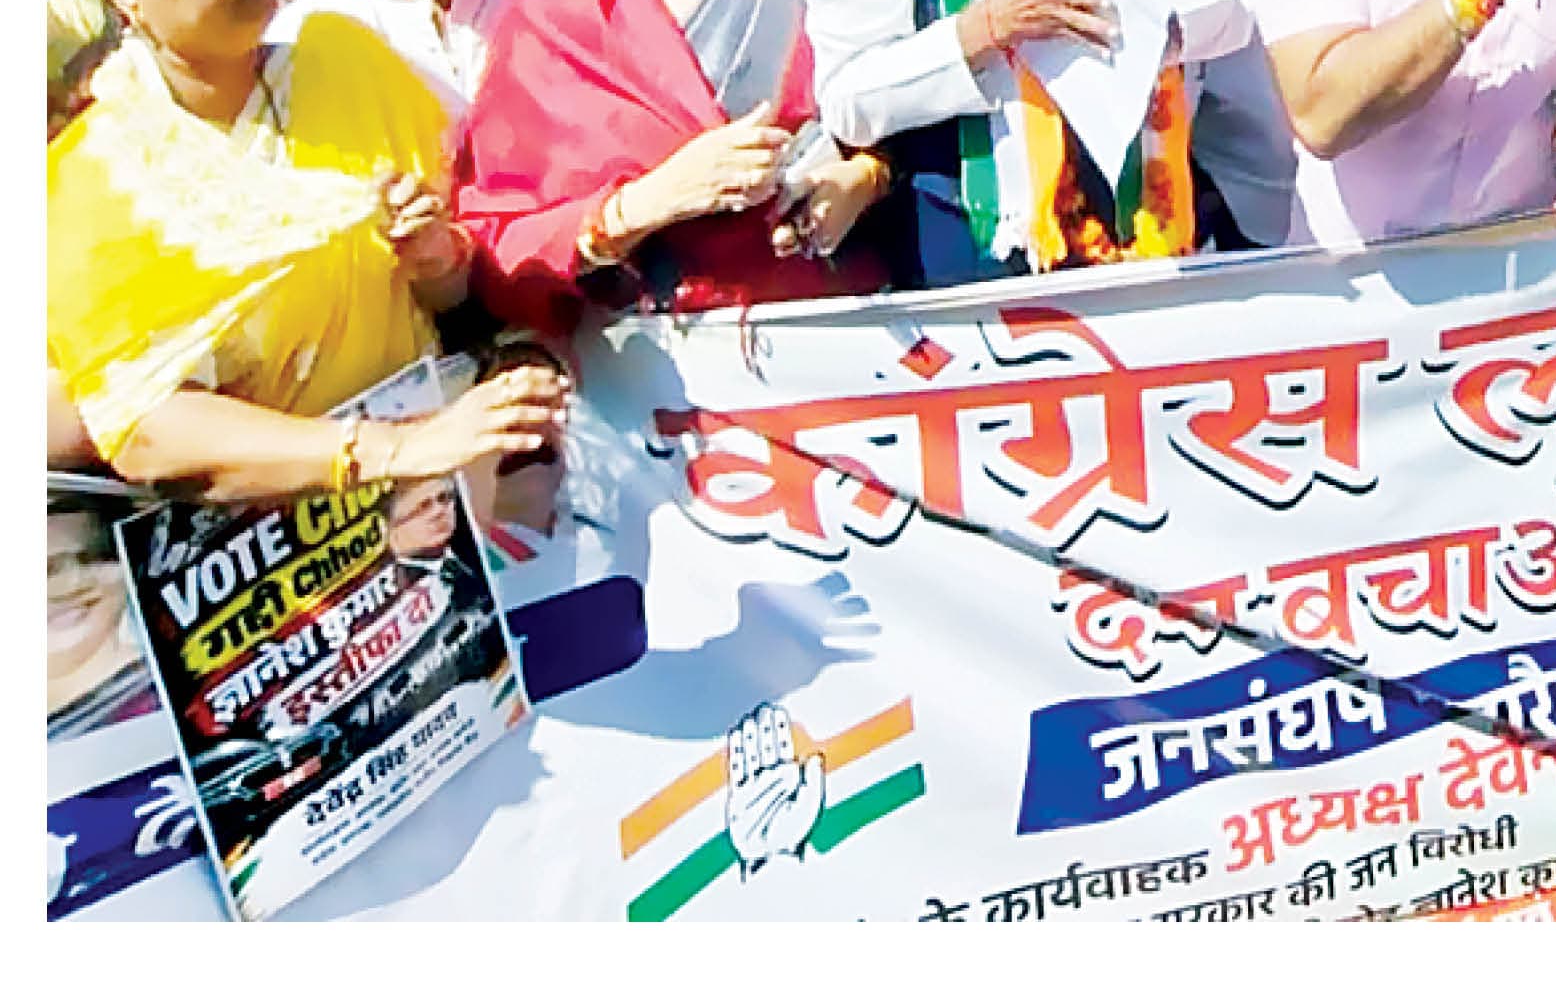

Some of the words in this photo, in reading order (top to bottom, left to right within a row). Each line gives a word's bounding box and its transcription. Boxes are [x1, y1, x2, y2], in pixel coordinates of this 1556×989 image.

[650, 304, 1397, 555] कांग्रेस
[160, 511, 293, 628] VOTE
[315, 562, 400, 651] कुमार
[981, 848, 1210, 922] कार्यवाहक
[1221, 771, 1424, 874] अध्यक्ष
[1286, 858, 1338, 908] की
[1345, 842, 1400, 892] जन
[1406, 813, 1521, 867] विरोधी
